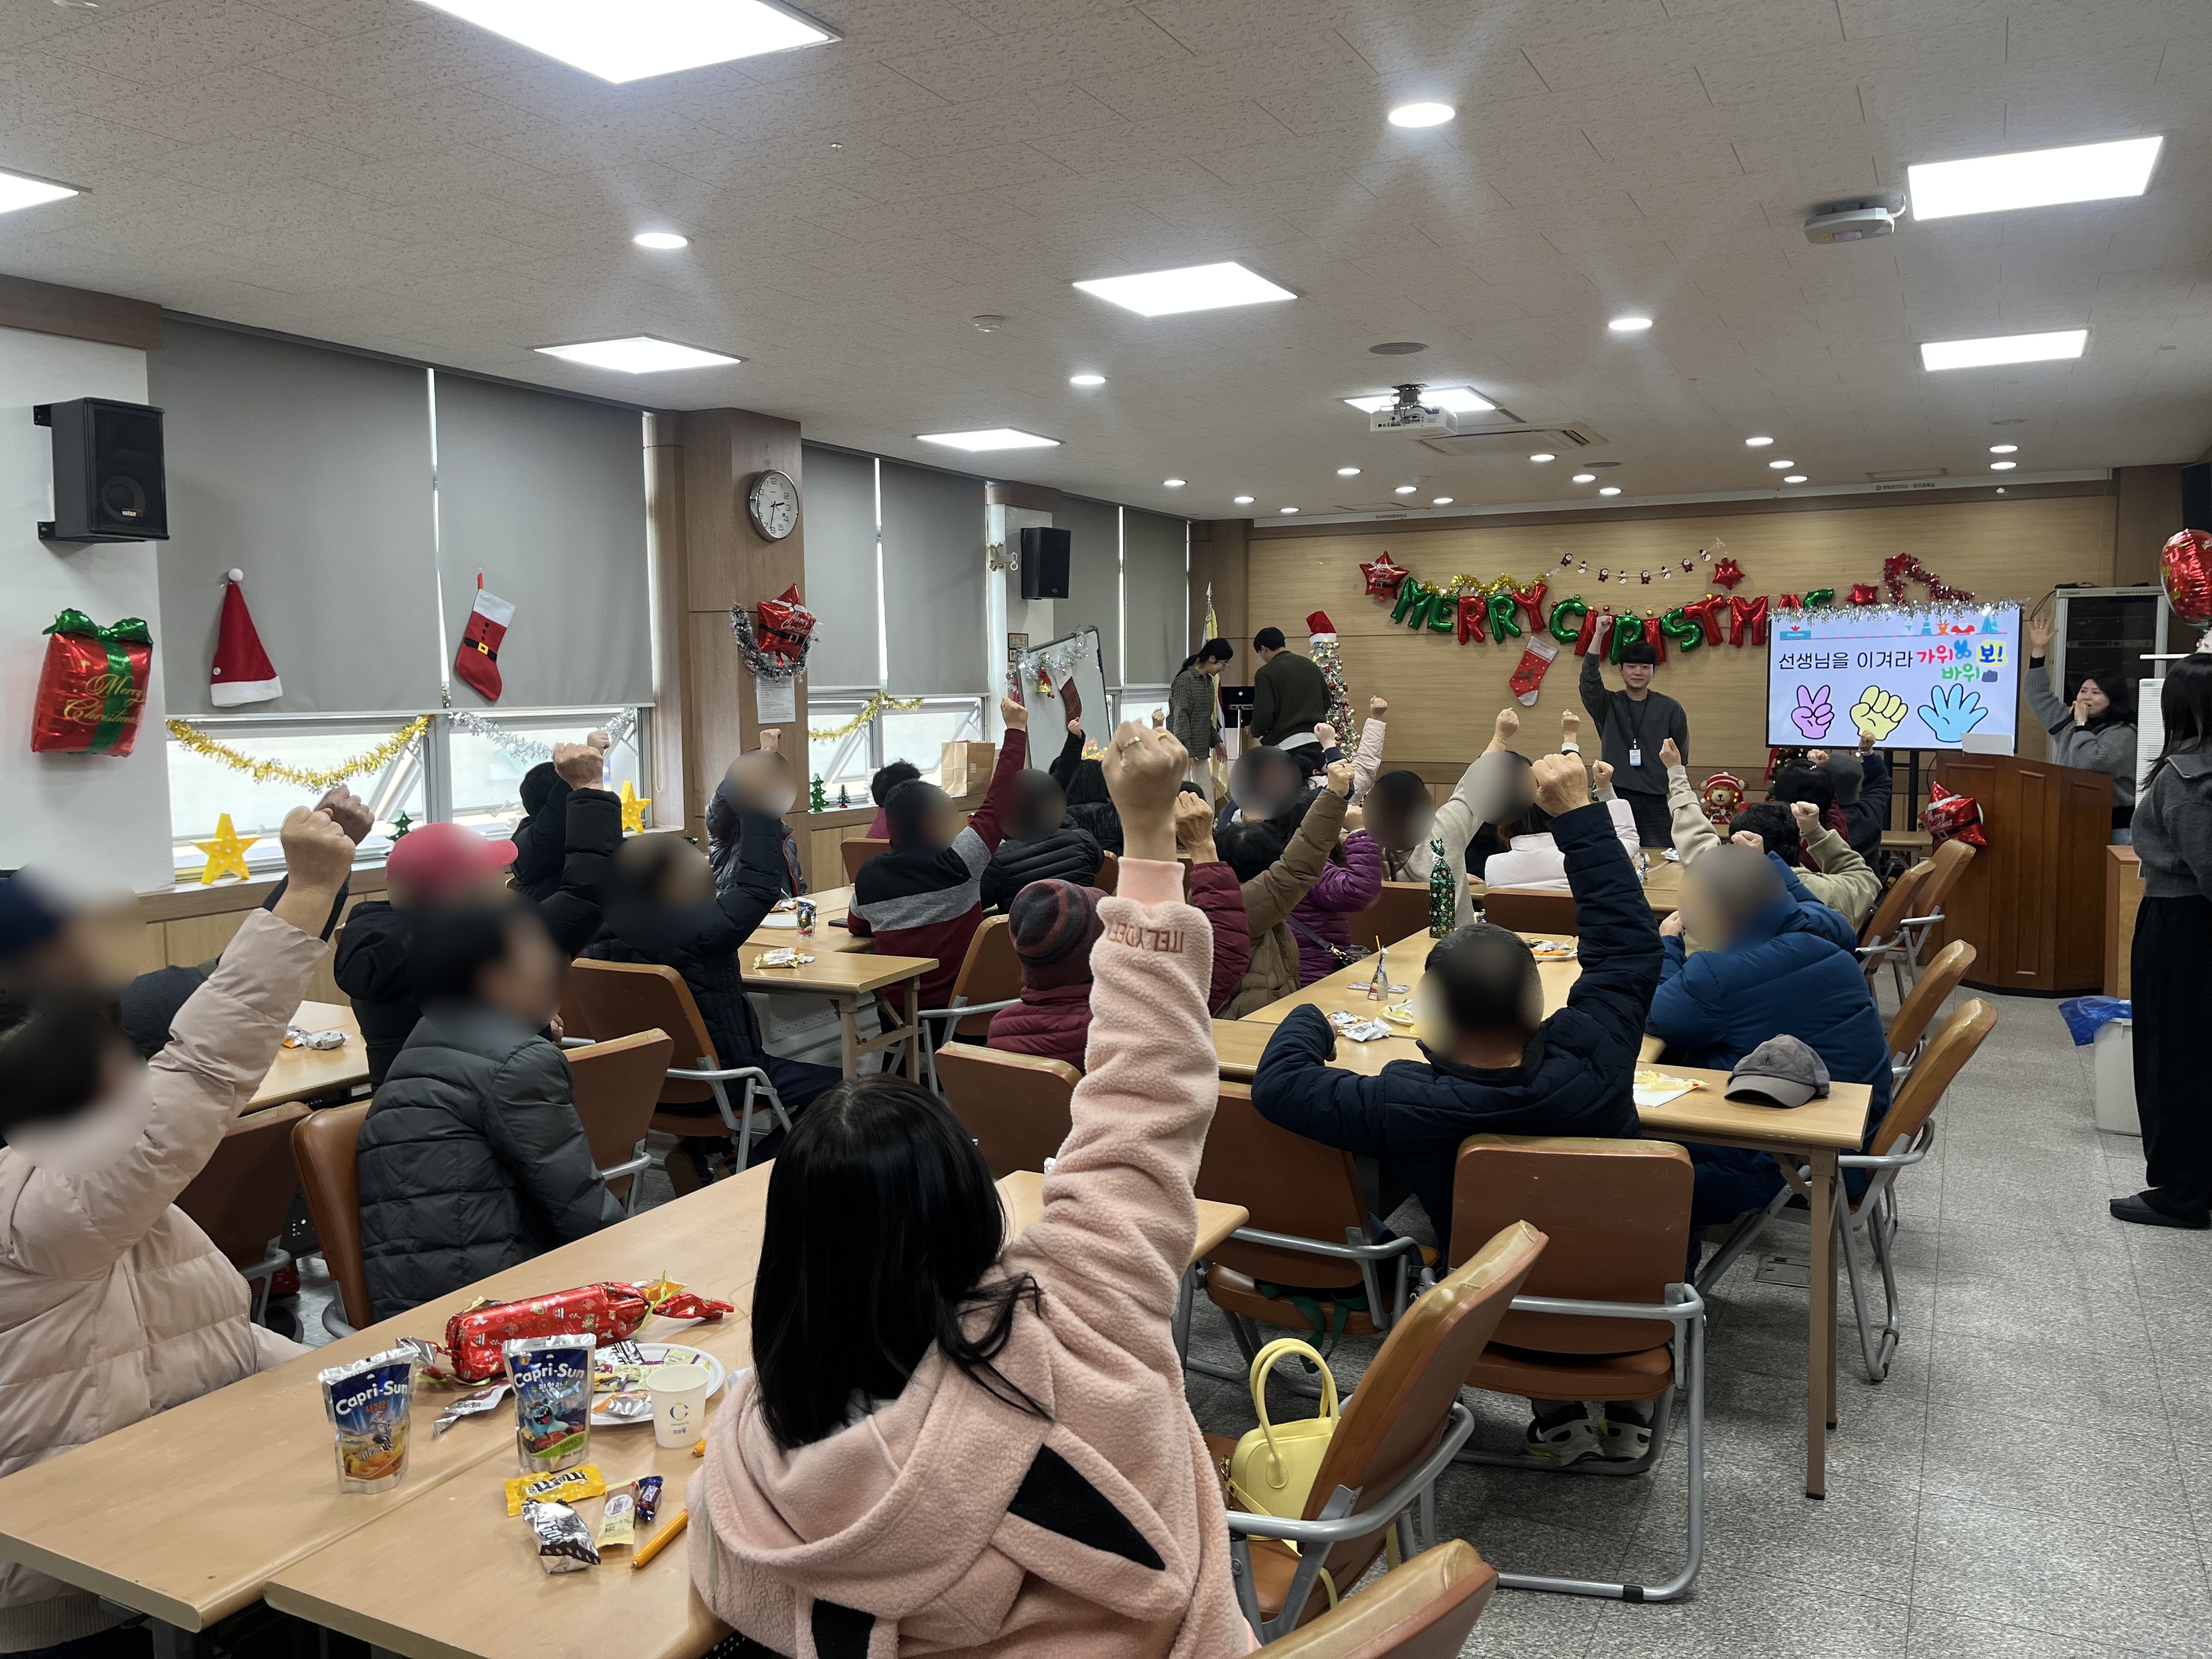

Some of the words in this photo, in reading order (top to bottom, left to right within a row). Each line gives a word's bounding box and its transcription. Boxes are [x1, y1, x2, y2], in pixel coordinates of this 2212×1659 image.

[1390, 577, 1548, 645] MERRY
[1779, 652, 1849, 669] 선생님을
[1857, 651, 1914, 669] 이겨라
[1916, 644, 1954, 665] 가위
[1979, 644, 2004, 663] 보!
[1942, 663, 1980, 682] 바위
[85, 673, 145, 707] Merry
[514, 1363, 585, 1388] Capri-Sun
[335, 1380, 408, 1415] Capri-Sun
